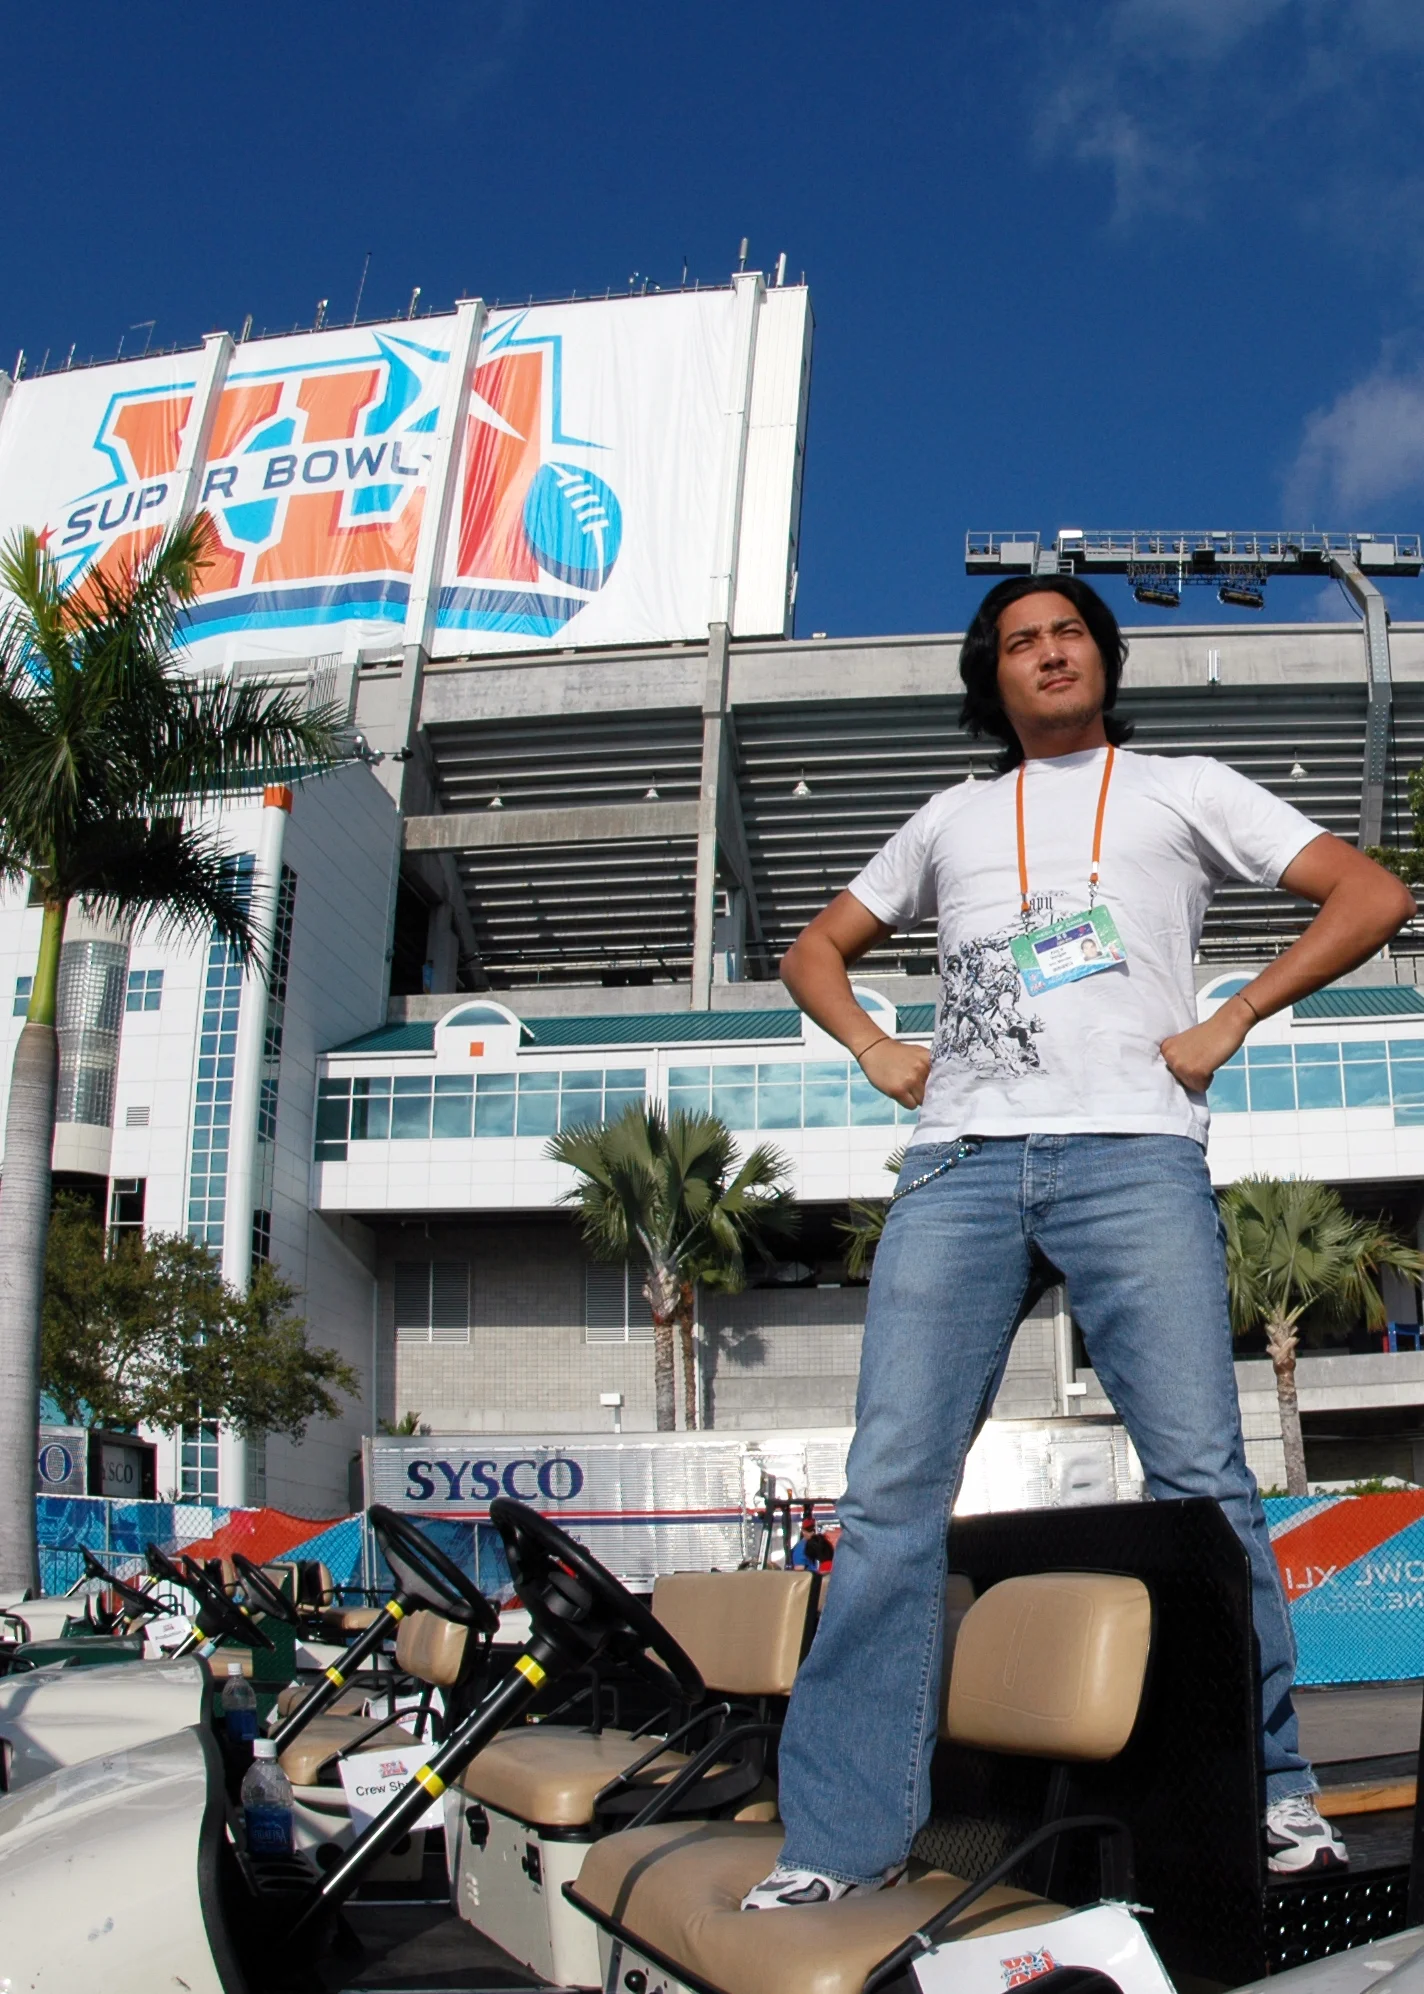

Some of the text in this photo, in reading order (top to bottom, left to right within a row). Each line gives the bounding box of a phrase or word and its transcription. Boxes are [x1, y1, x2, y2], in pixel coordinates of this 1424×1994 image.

[61, 441, 424, 546] SUPR BOWL
[405, 1458, 584, 1501] SYSCO
[356, 1784, 386, 1797] Crew
